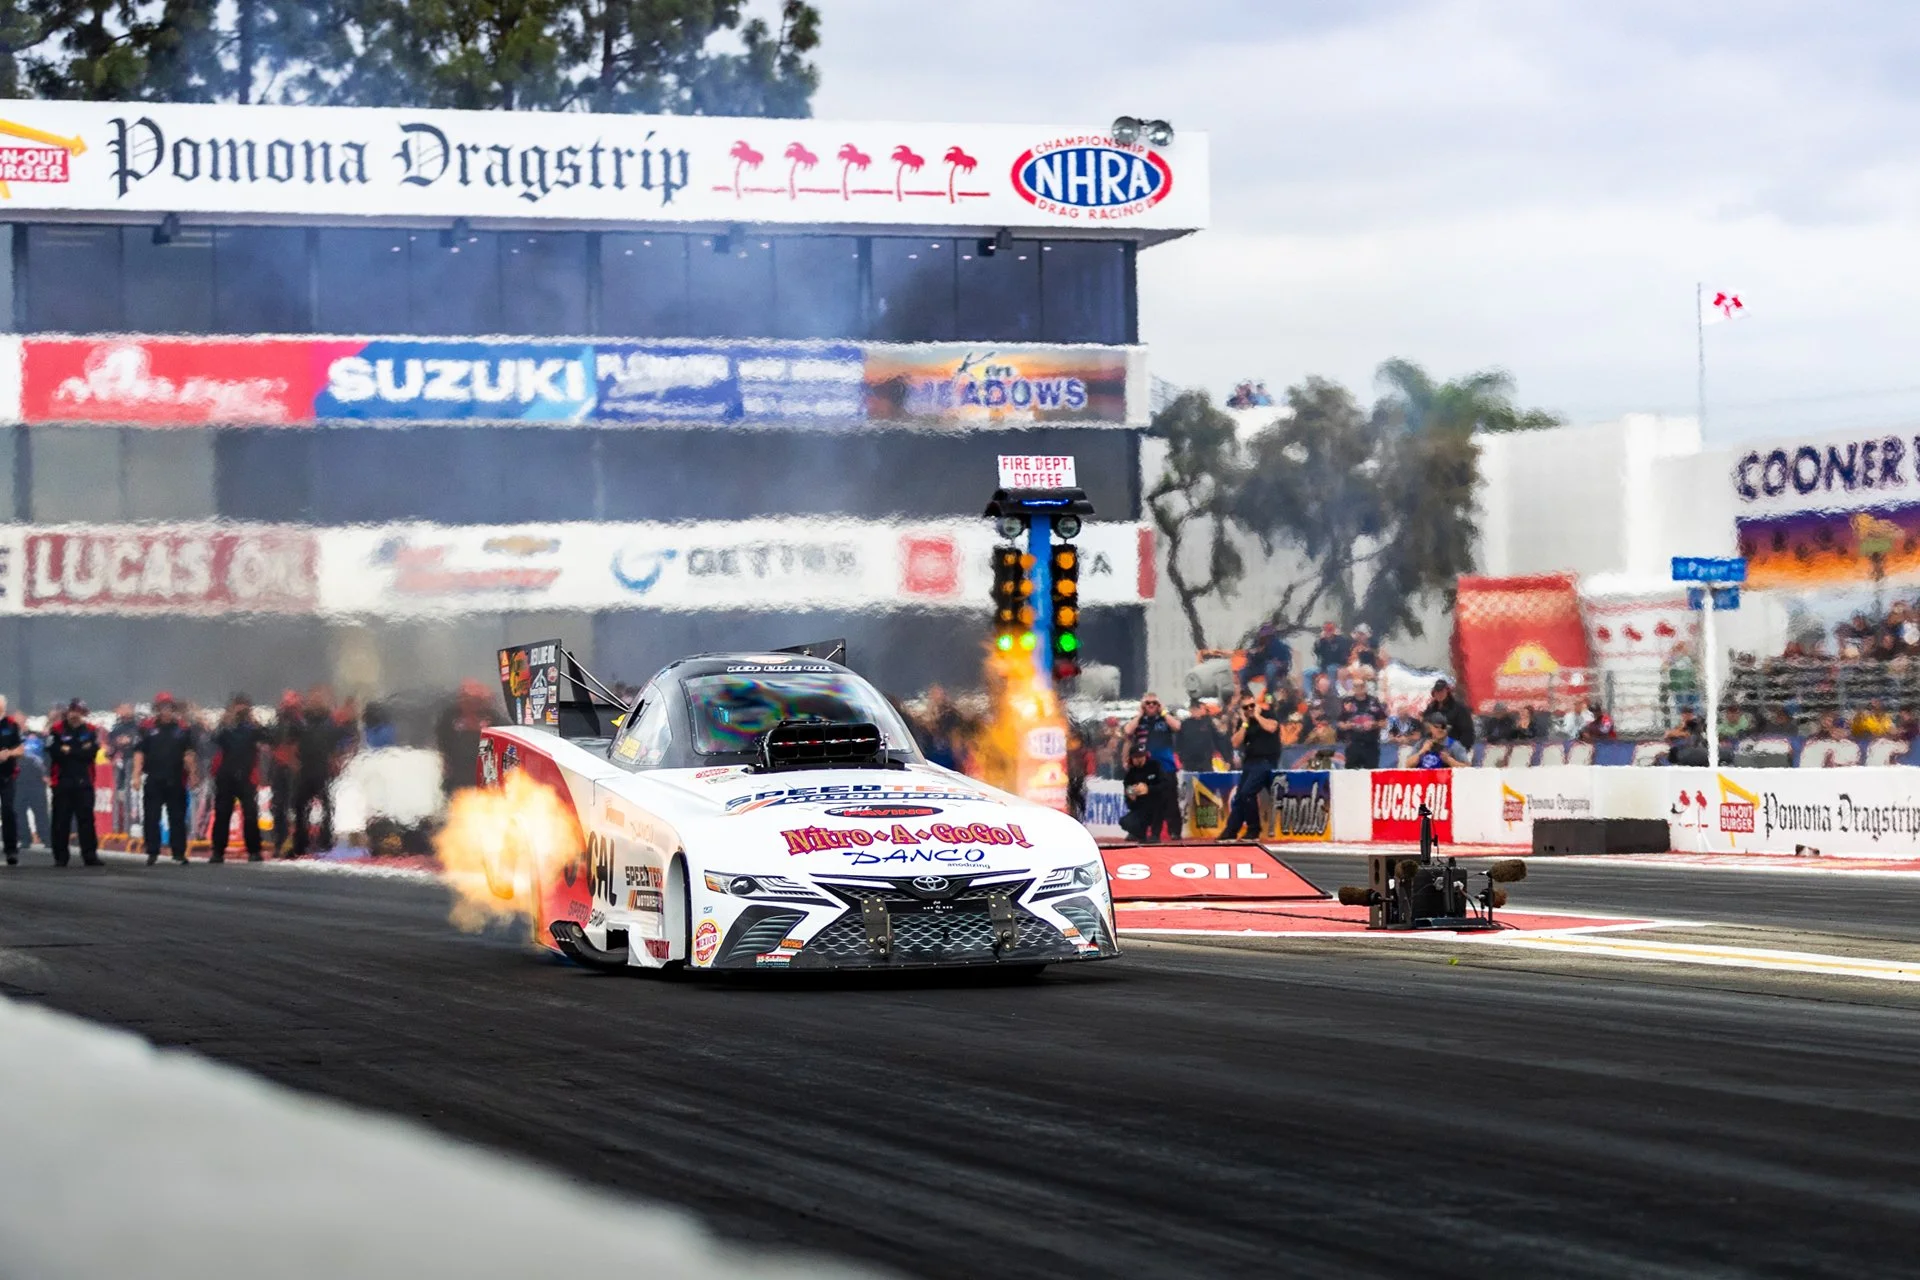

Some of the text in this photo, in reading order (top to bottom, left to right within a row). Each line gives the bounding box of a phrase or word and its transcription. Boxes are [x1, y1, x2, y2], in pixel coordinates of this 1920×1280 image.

[106, 117, 691, 206] Pomona Dragstrip
[1035, 150, 1151, 204] NHRA
[1038, 199, 1145, 220] DRAG RACING
[327, 356, 588, 404] SUZUKI
[1002, 457, 1072, 471] FIRE DEPT.
[1014, 473, 1062, 487] COFFEE
[33, 540, 212, 598] LUCAS
[1373, 783, 1449, 821] LUCAS OIL
[1720, 803, 1754, 819] IN-N-OUT
[1720, 816, 1754, 832] BURGER
[1763, 792, 1832, 840] Pomona
[842, 848, 985, 866] DANCO
[1169, 862, 1269, 880] OIL
